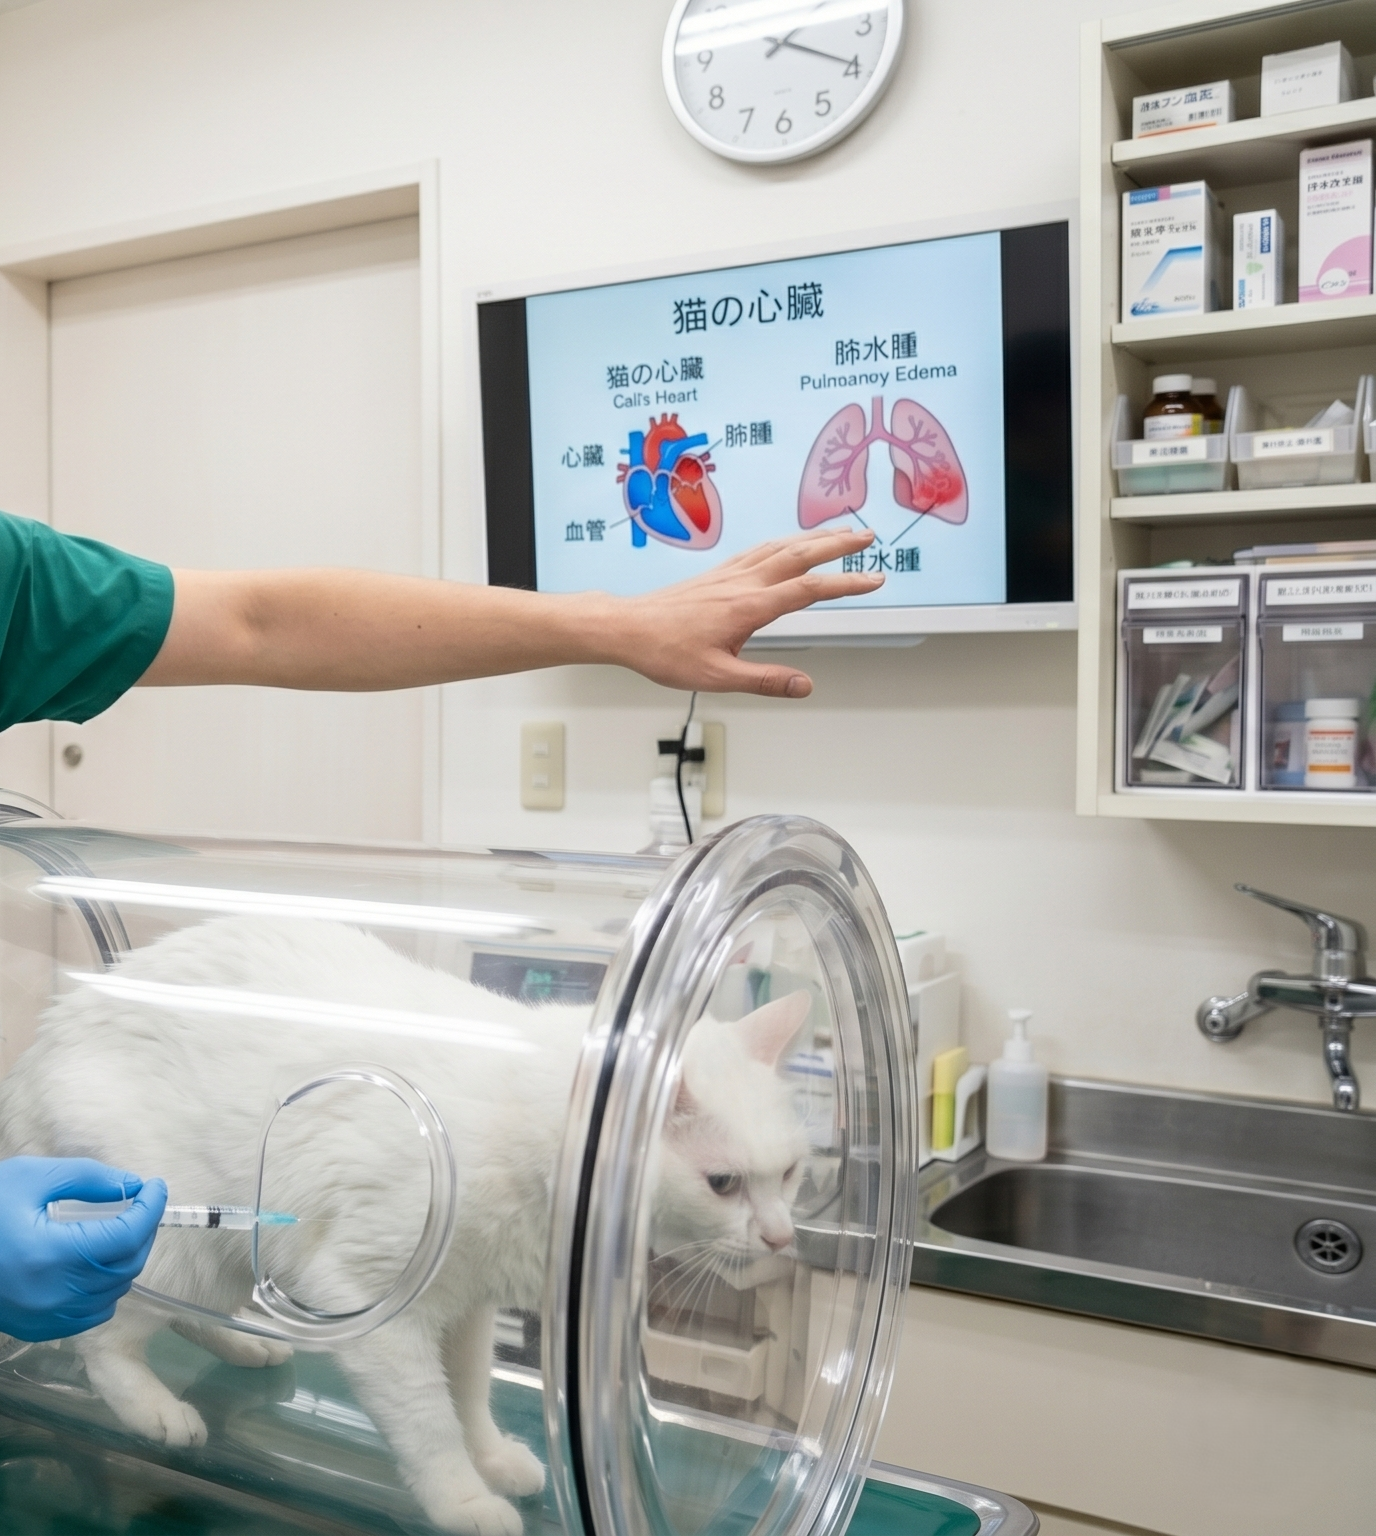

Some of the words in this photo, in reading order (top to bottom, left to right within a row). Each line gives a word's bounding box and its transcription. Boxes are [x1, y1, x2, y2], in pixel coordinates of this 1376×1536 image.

[855, 13, 872, 37] 3
[697, 50, 713, 72] 9
[842, 54, 862, 79] 4
[709, 85, 724, 110] 8
[814, 90, 831, 117] 5
[739, 107, 754, 134] 7
[775, 109, 792, 134] 6
[673, 281, 824, 335] 猫の心臓
[835, 331, 918, 366] 肺水腫
[607, 356, 705, 390] 猫の心臓
[896, 364, 957, 382] Edema
[655, 387, 698, 405] Heart
[565, 519, 606, 542] 血管
